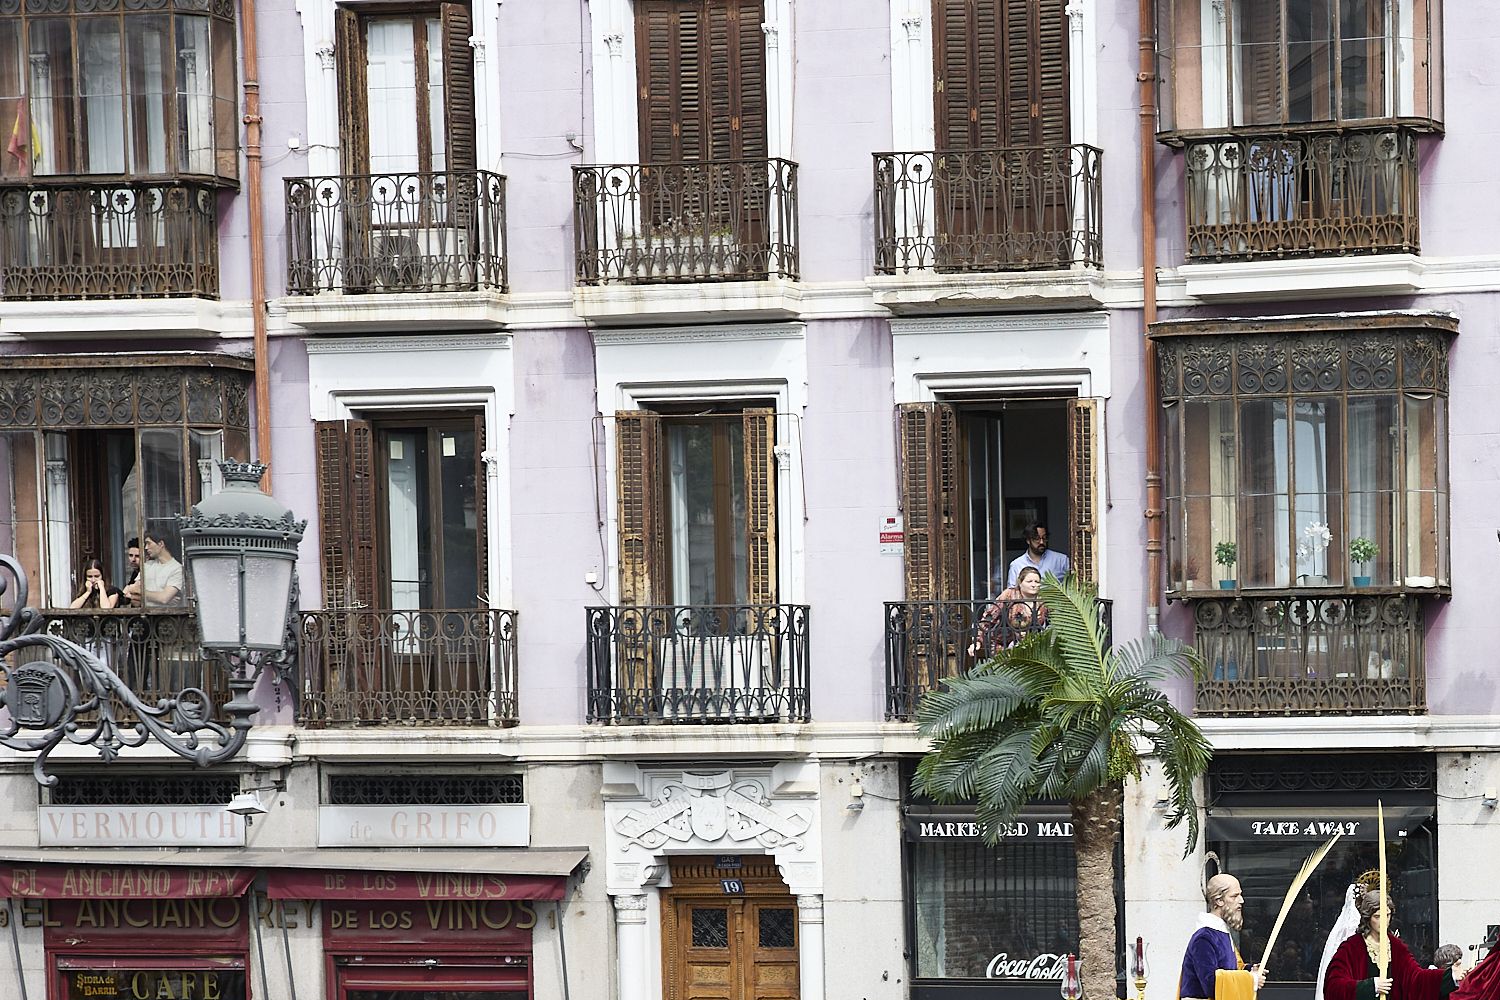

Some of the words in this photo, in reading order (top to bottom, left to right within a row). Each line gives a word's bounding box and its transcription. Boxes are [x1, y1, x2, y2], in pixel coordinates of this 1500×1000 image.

[881, 533, 903, 541] Alarma
[47, 811, 237, 840] VERMOUTH
[350, 820, 373, 840] de
[390, 810, 497, 841] GRIFO
[998, 822, 1029, 837] OLD
[1252, 821, 1299, 836] TAKE
[1304, 821, 1360, 836] AWAY
[12, 868, 46, 896] EL
[61, 868, 171, 897] ANCIANO
[187, 869, 243, 897] REY
[325, 873, 346, 890] DE
[363, 873, 396, 891] LOS
[416, 873, 508, 898] VINOS
[723, 881, 740, 893] 19
[21, 898, 63, 929] EL
[76, 898, 241, 929] ANCIANO
[256, 892, 317, 929] REY
[331, 910, 358, 929] DE
[369, 909, 413, 929] LOS
[425, 900, 538, 931] VINOS
[84, 986, 118, 997] BARRIL
